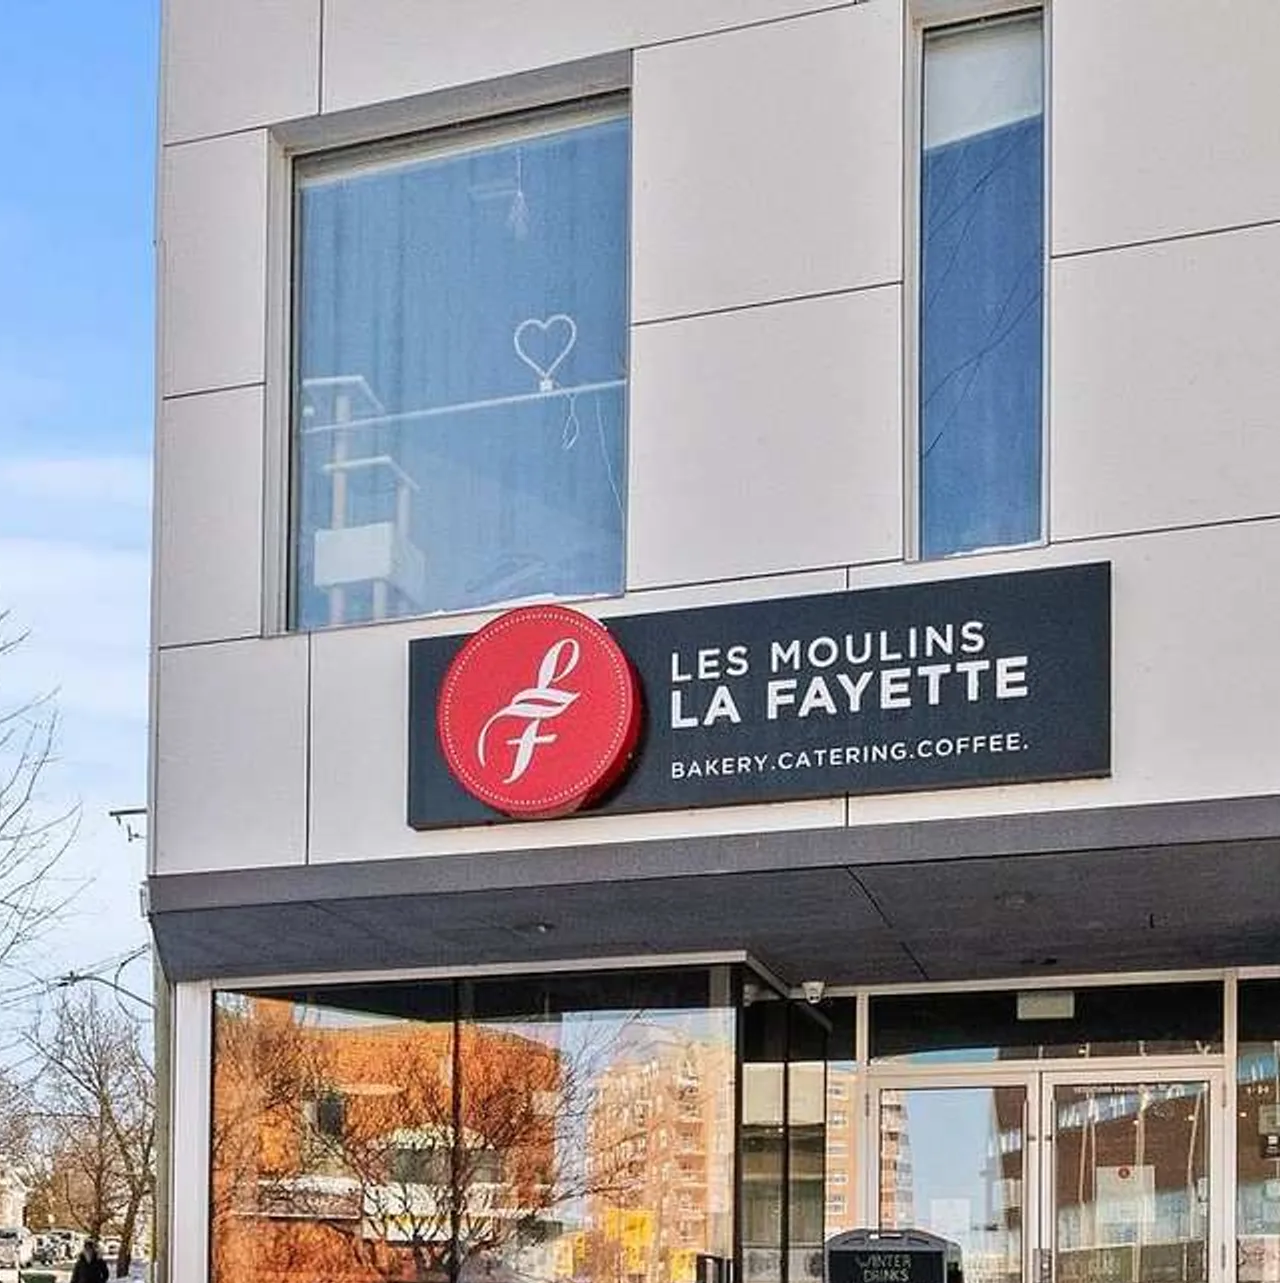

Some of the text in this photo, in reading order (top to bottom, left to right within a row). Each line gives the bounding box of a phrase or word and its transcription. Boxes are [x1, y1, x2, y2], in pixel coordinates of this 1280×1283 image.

[671, 621, 986, 682] LES MOULINS
[671, 655, 1029, 729] LA FAYETTE
[855, 1254, 912, 1268] WINTER
[863, 1268, 910, 1283] DRINKS
